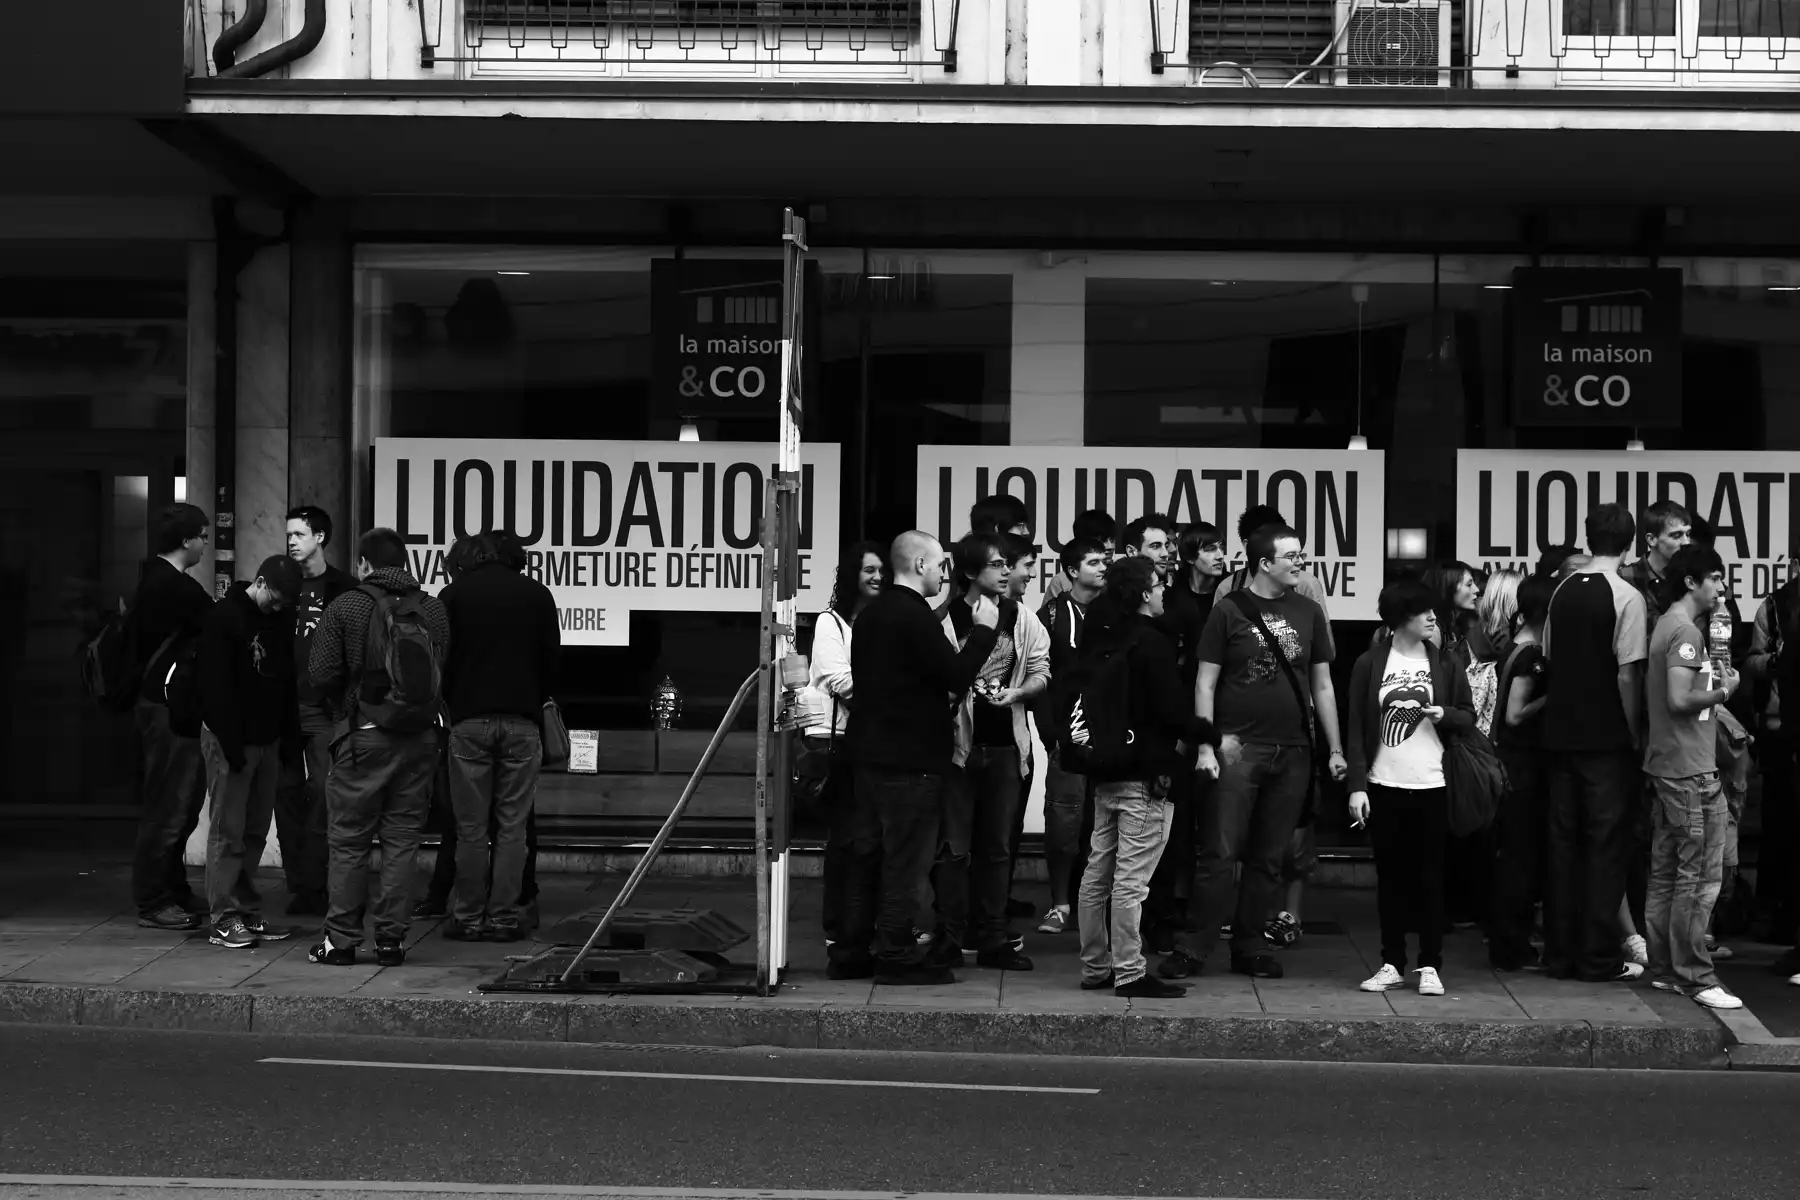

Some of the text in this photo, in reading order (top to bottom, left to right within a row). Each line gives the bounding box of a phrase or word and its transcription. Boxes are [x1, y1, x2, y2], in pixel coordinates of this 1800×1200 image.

[680, 334, 698, 354] la
[1544, 343, 1652, 363] la maison
[527, 543, 811, 590] RMETURE DÉFINITE
